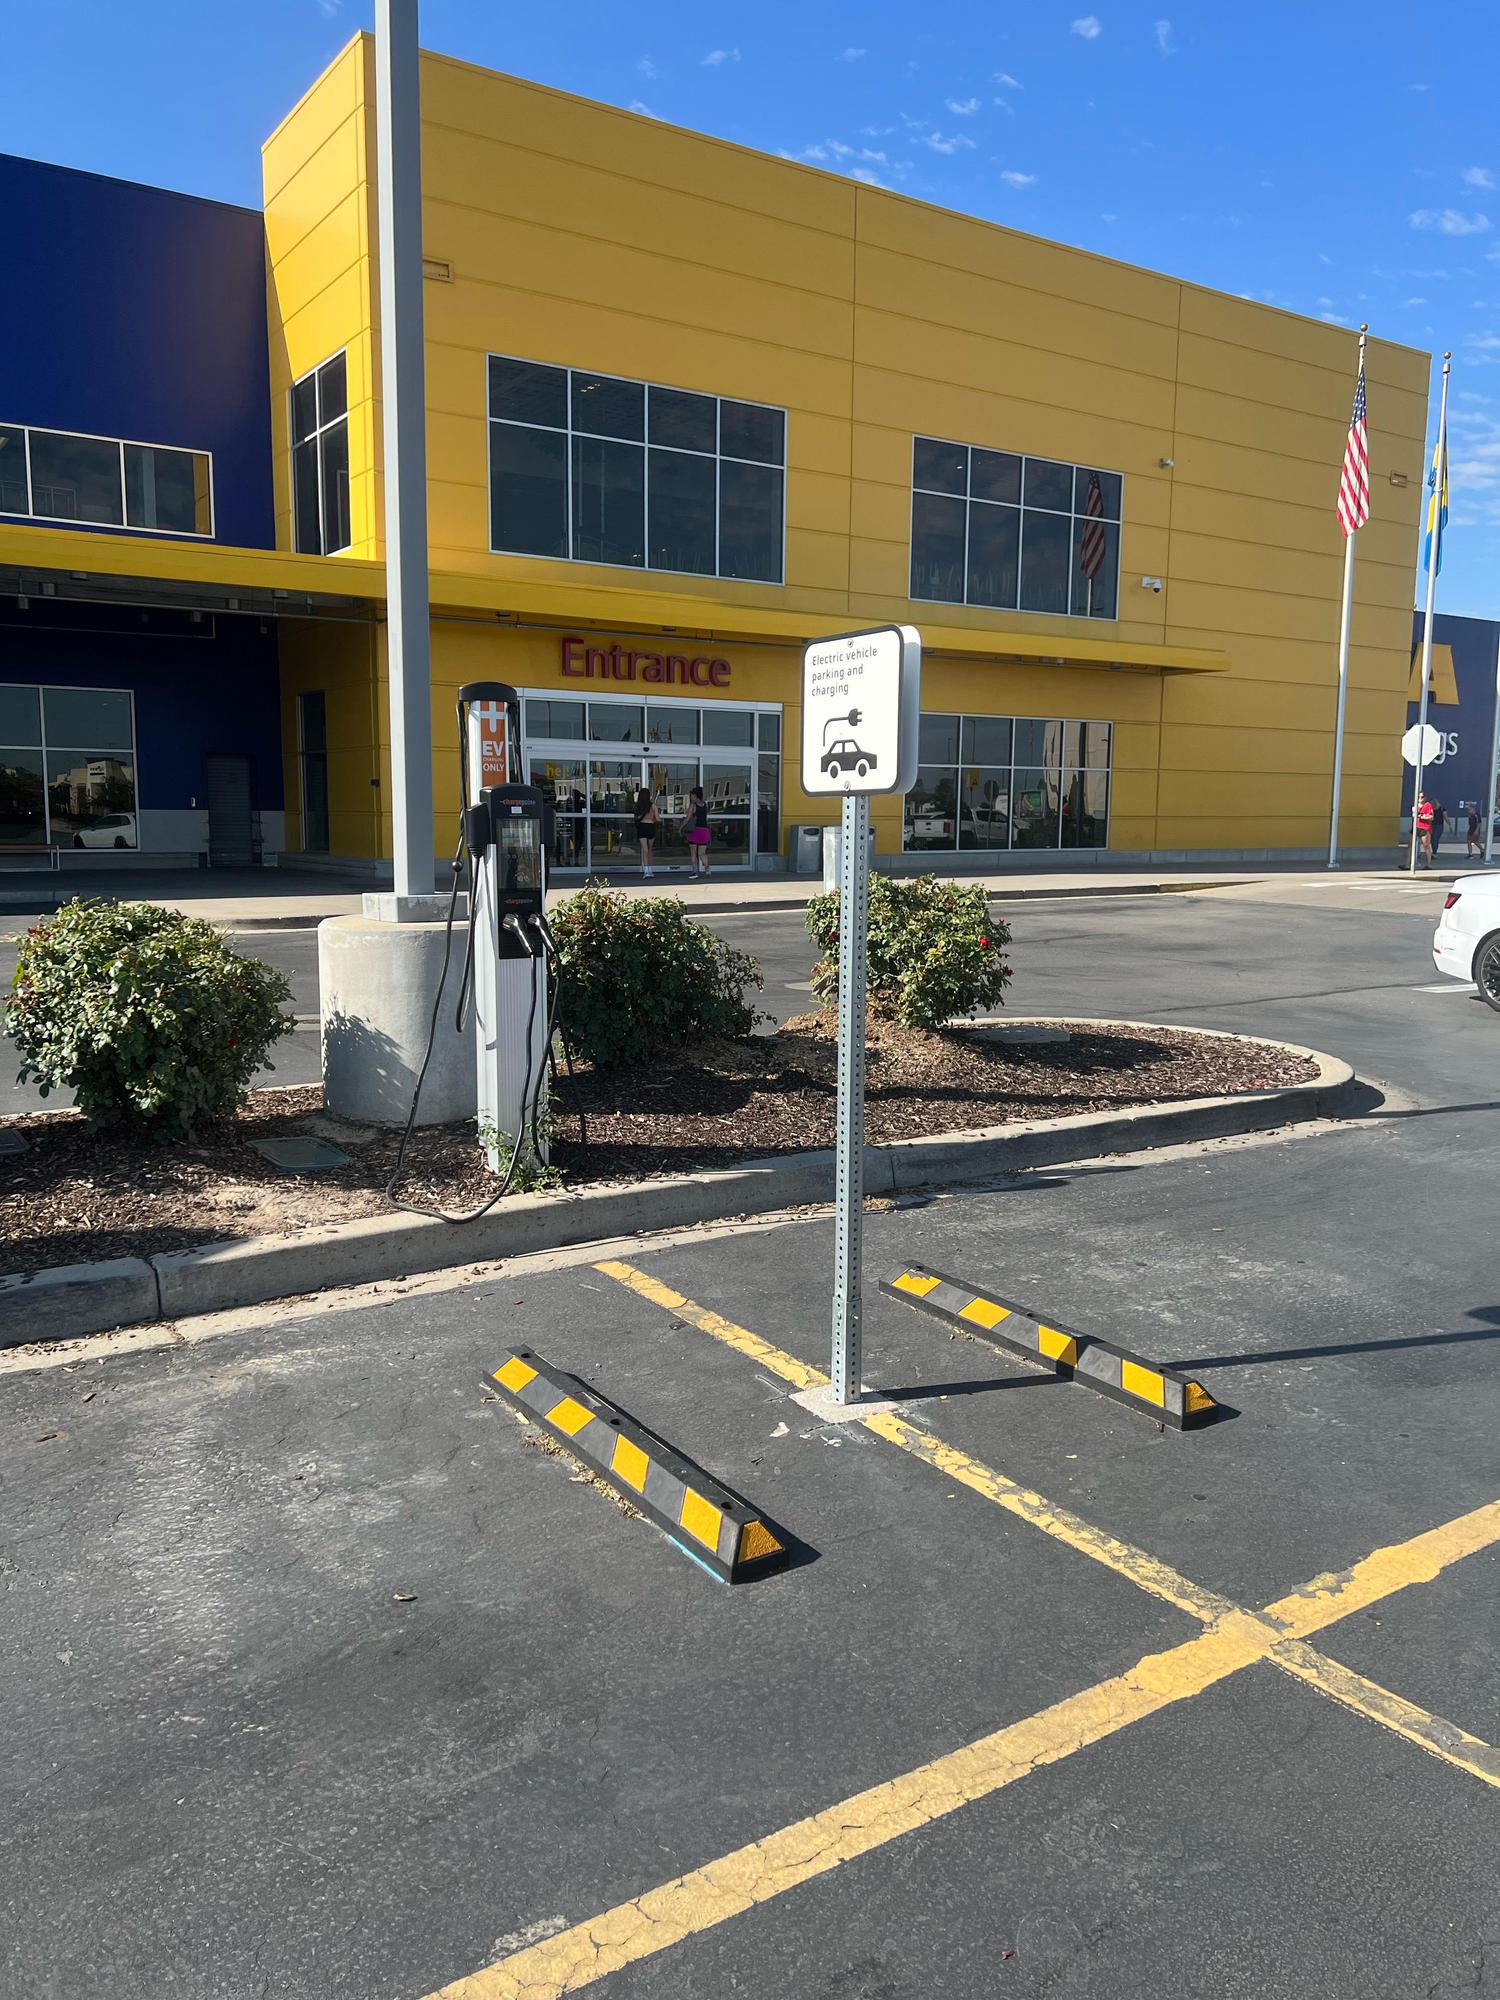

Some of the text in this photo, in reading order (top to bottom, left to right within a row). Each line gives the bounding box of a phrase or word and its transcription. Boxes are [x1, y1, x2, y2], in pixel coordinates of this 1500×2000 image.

[562, 637, 732, 687] Entrance
[812, 646, 878, 666] Electric vehicle
[812, 663, 864, 684] parking and
[812, 683, 848, 697] charging
[482, 740, 504, 756] EV
[483, 763, 505, 772] ONLY
